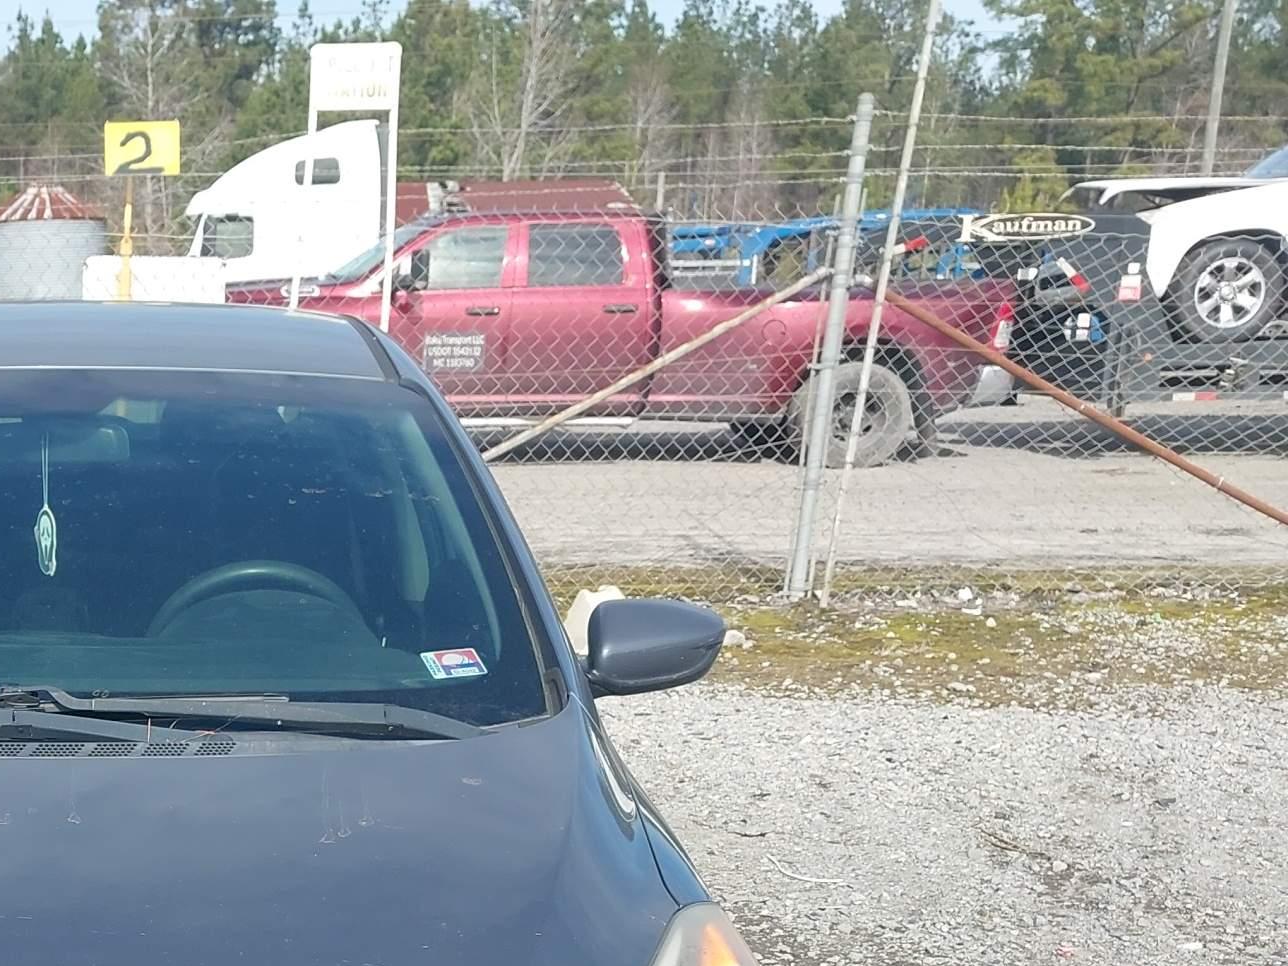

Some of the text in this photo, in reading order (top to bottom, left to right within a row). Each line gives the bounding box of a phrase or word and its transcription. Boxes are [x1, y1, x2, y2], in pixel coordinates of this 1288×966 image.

[112, 131, 165, 175] 2
[955, 213, 1082, 242] Kaufman
[473, 335, 485, 345] LLC
